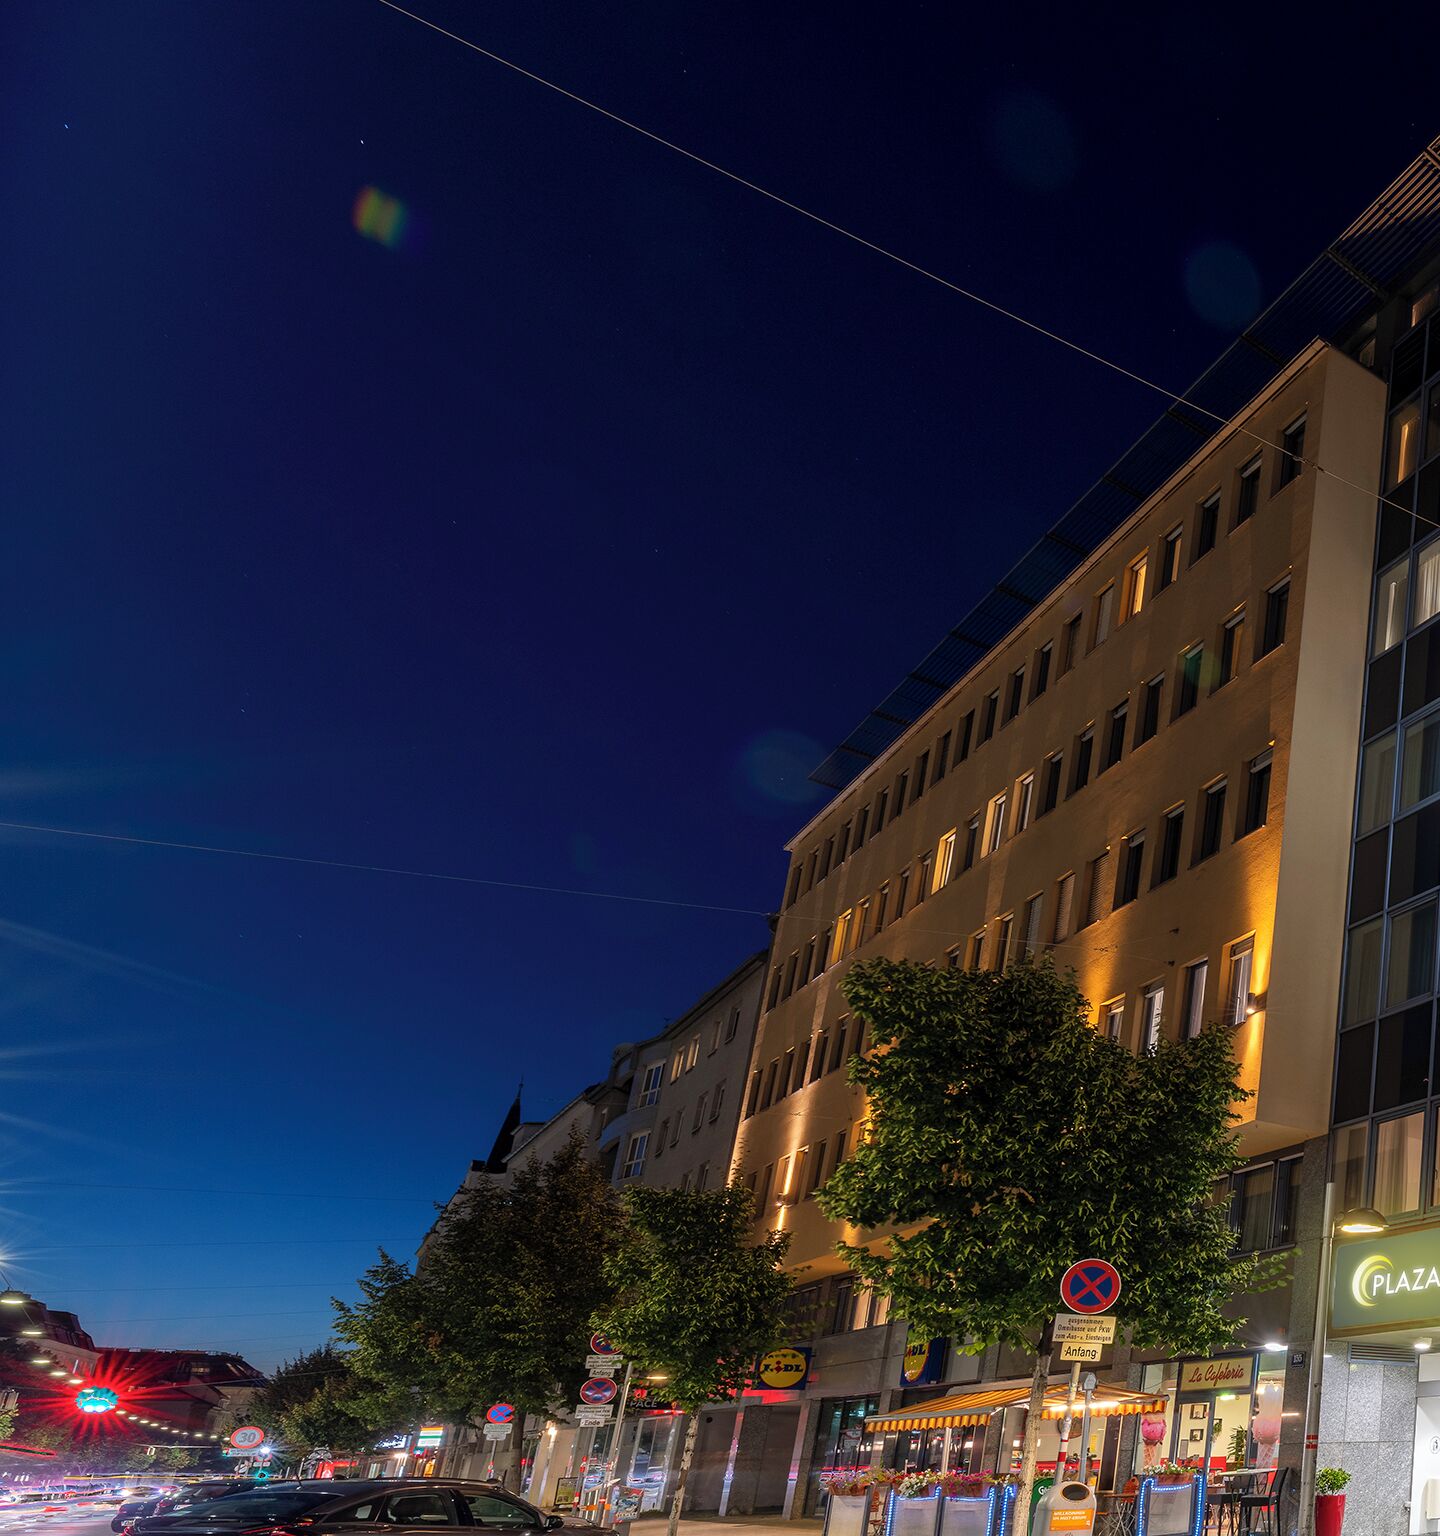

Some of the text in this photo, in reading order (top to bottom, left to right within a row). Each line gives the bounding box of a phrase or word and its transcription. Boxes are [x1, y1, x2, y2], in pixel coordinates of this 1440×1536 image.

[1372, 1266, 1440, 1297] PLAZA
[1098, 1325, 1111, 1333] PKW
[1065, 1346, 1097, 1359] Anfang
[1188, 1361, 1244, 1387] La Cafeteria
[239, 1432, 257, 1443] 30
